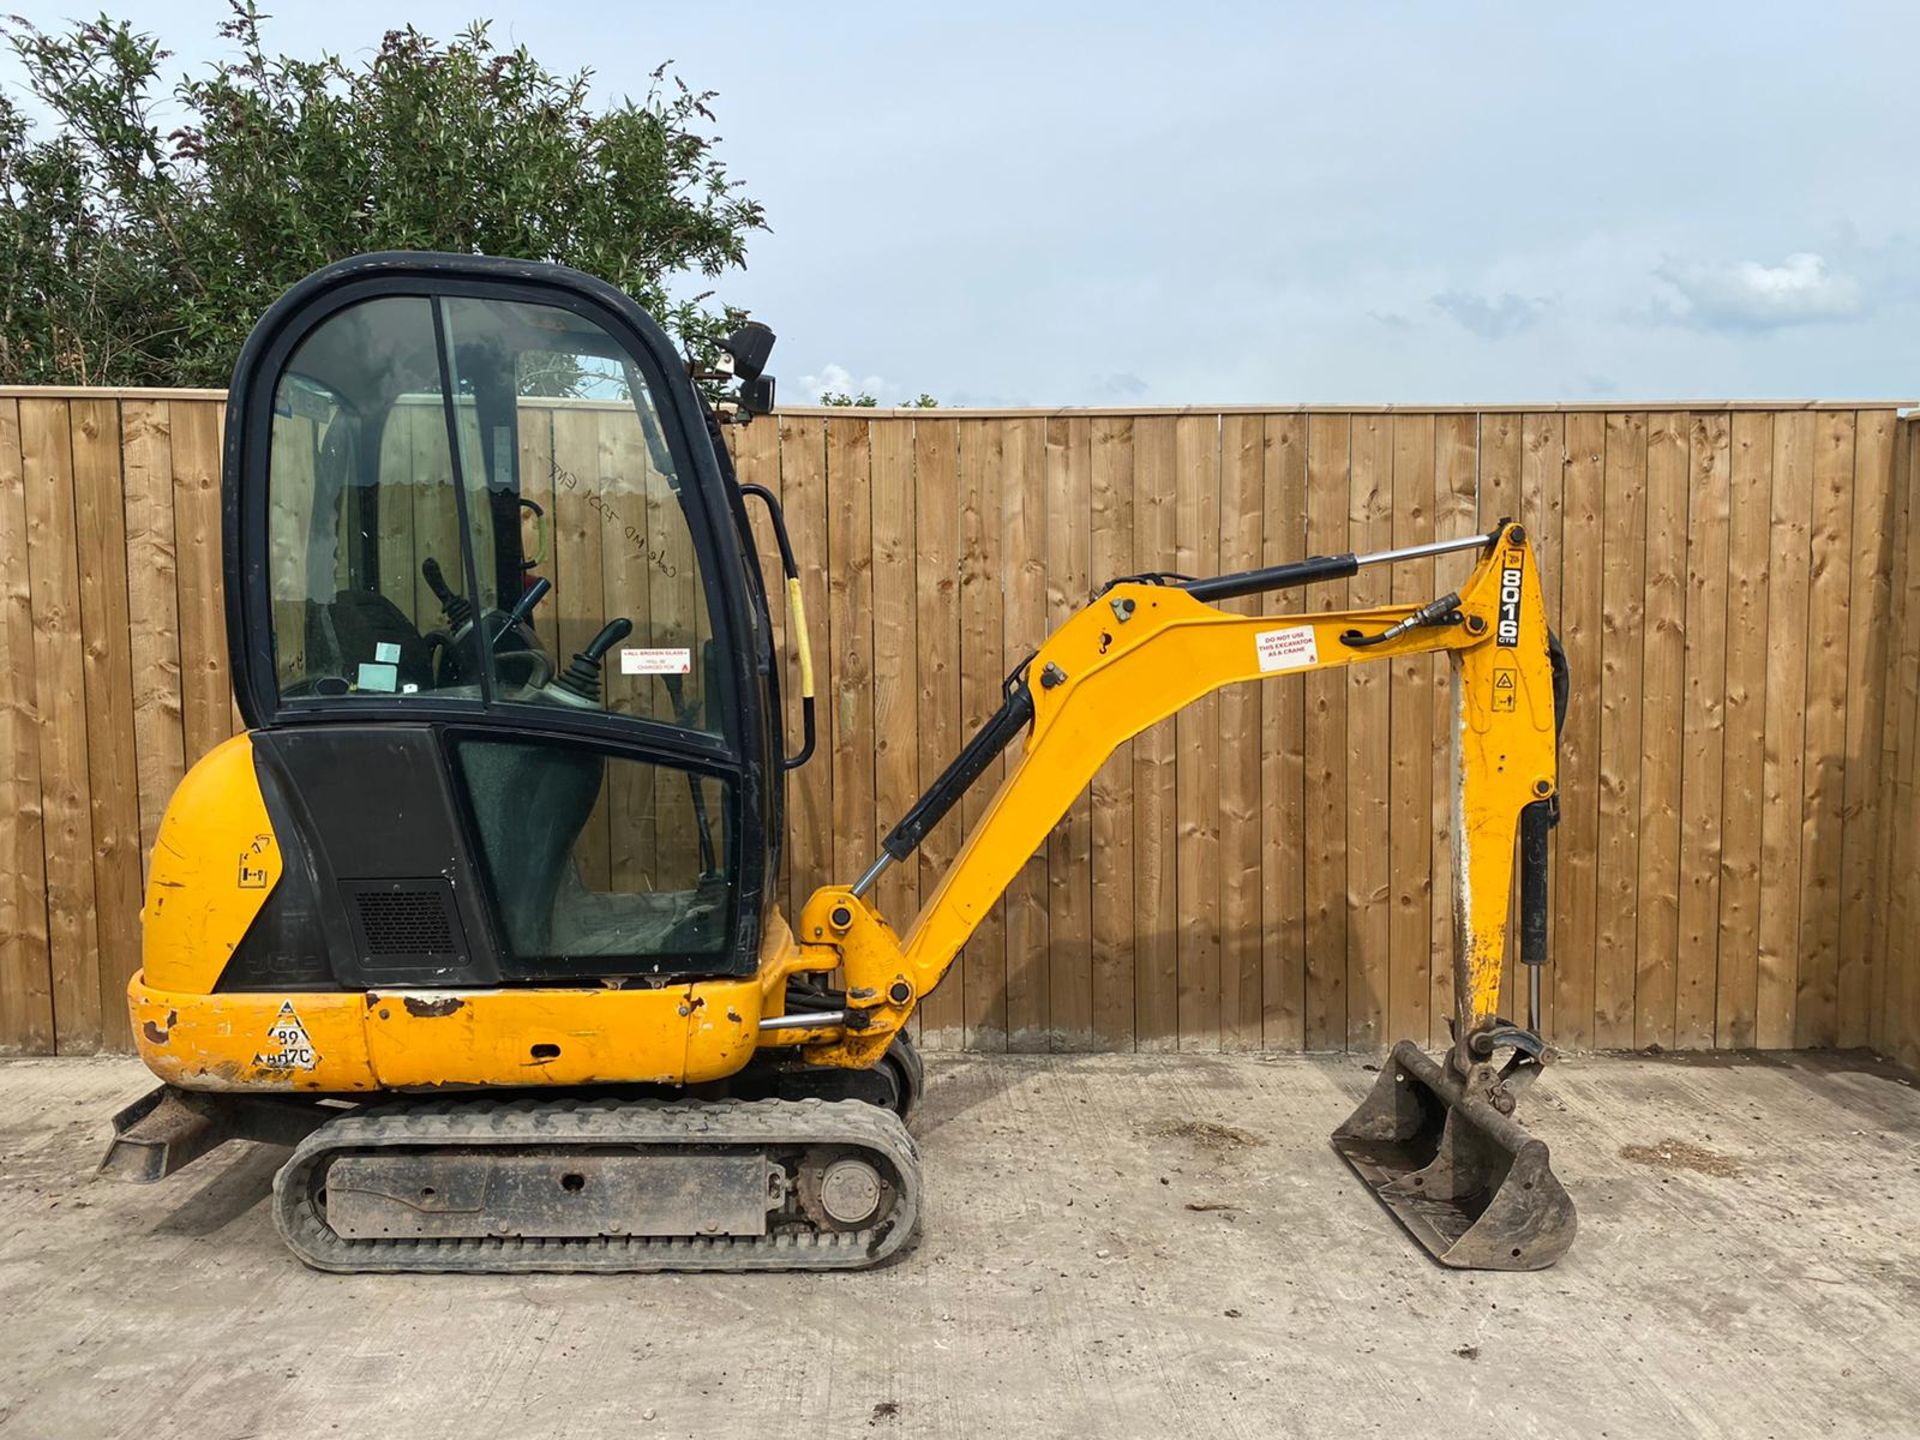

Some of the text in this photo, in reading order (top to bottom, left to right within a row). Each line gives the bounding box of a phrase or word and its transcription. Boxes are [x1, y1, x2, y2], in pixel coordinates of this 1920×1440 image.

[1499, 569, 1521, 637] 8016
[1275, 638, 1313, 650] EXCAVATOR
[1283, 646, 1305, 655] CRANE
